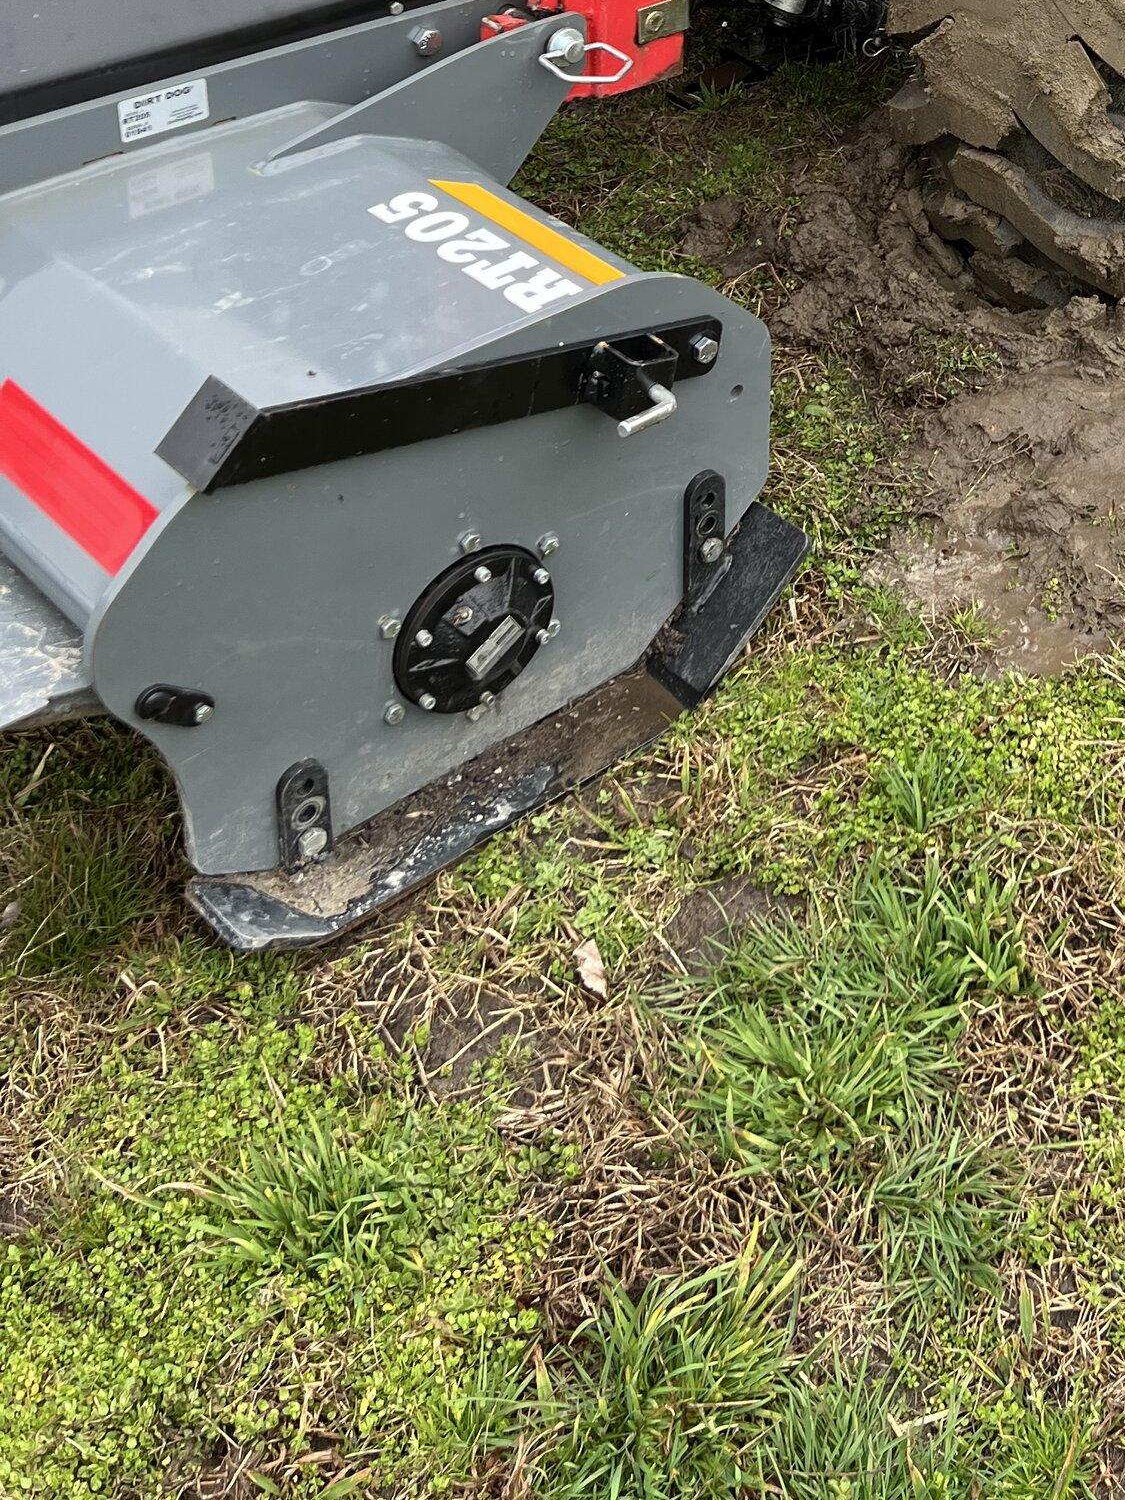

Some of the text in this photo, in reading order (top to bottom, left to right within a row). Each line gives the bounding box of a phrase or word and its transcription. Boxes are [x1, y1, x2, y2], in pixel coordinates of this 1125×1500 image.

[133, 86, 192, 109] DIRT DOG
[367, 191, 584, 314] RT205
